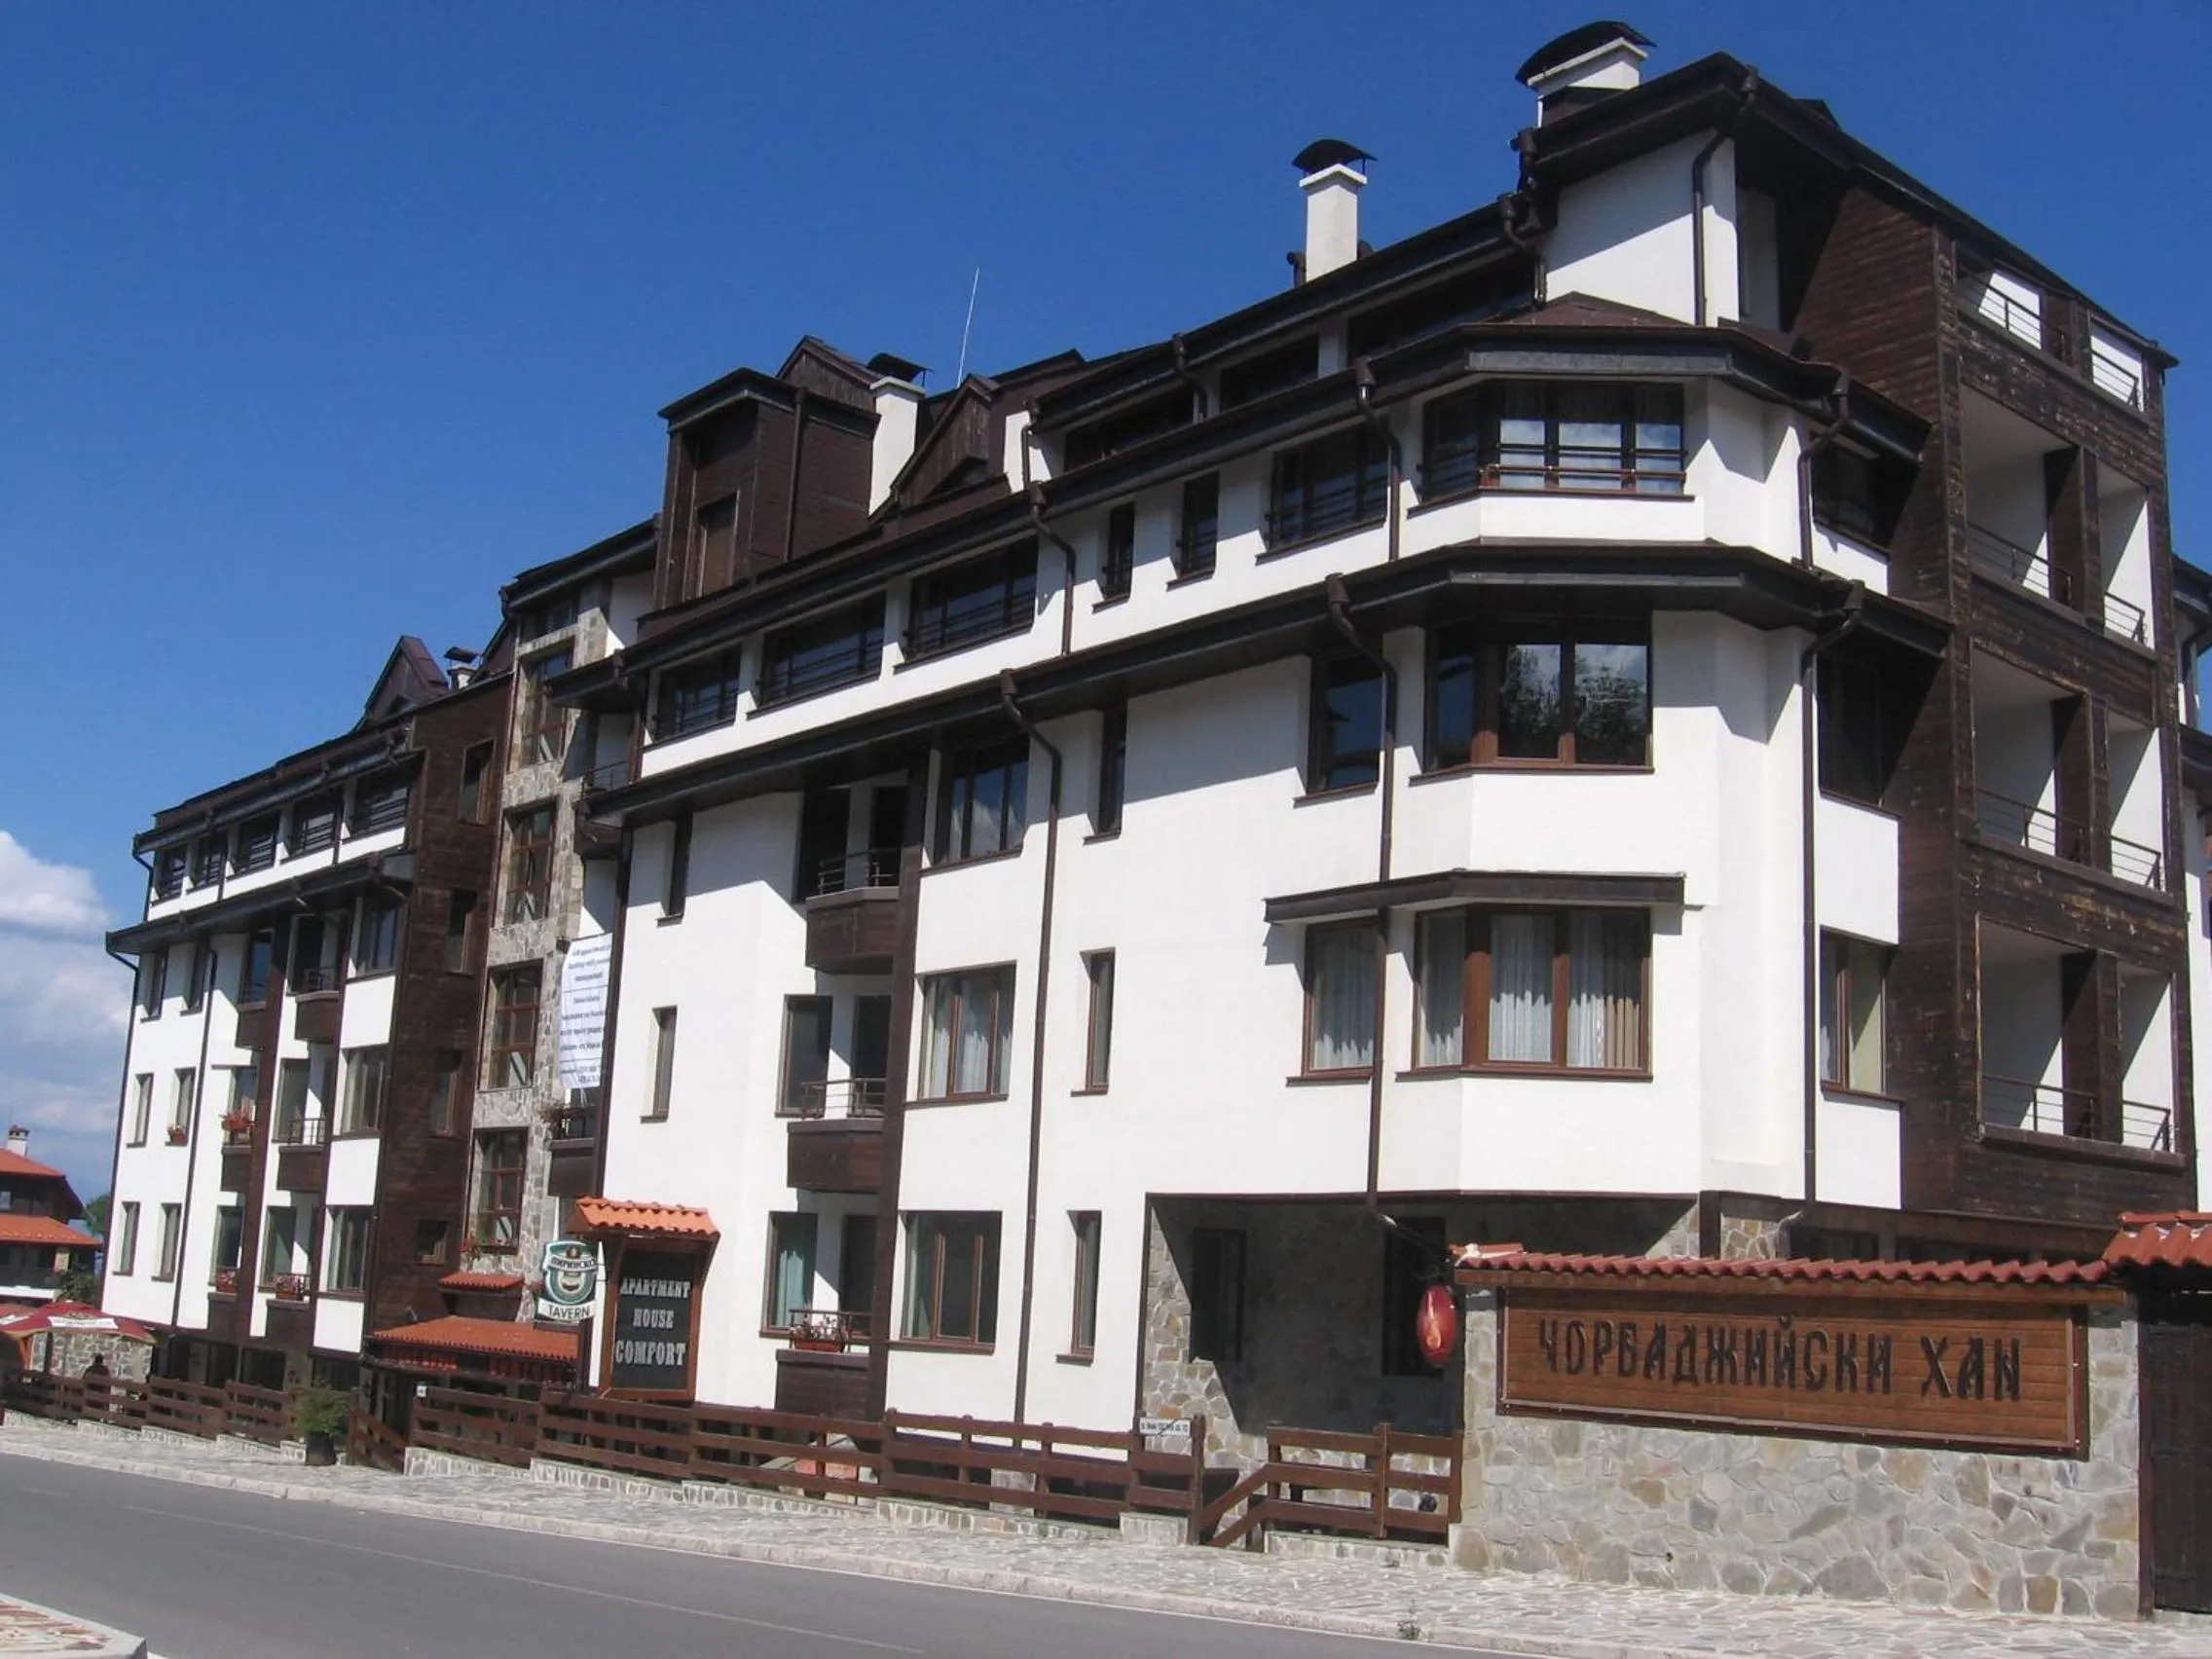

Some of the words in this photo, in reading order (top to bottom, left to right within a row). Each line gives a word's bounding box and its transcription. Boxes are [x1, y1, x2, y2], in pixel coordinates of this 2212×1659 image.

[620, 1277, 690, 1299] APARTMENT
[548, 1305, 590, 1319] TAVERN
[634, 1309, 674, 1329] HOUSE
[615, 1340, 686, 1366] COMFORT
[1538, 1314, 1892, 1394] ЧОРБАДЖИЙСКИ
[1919, 1335, 2022, 1402] ХАН
